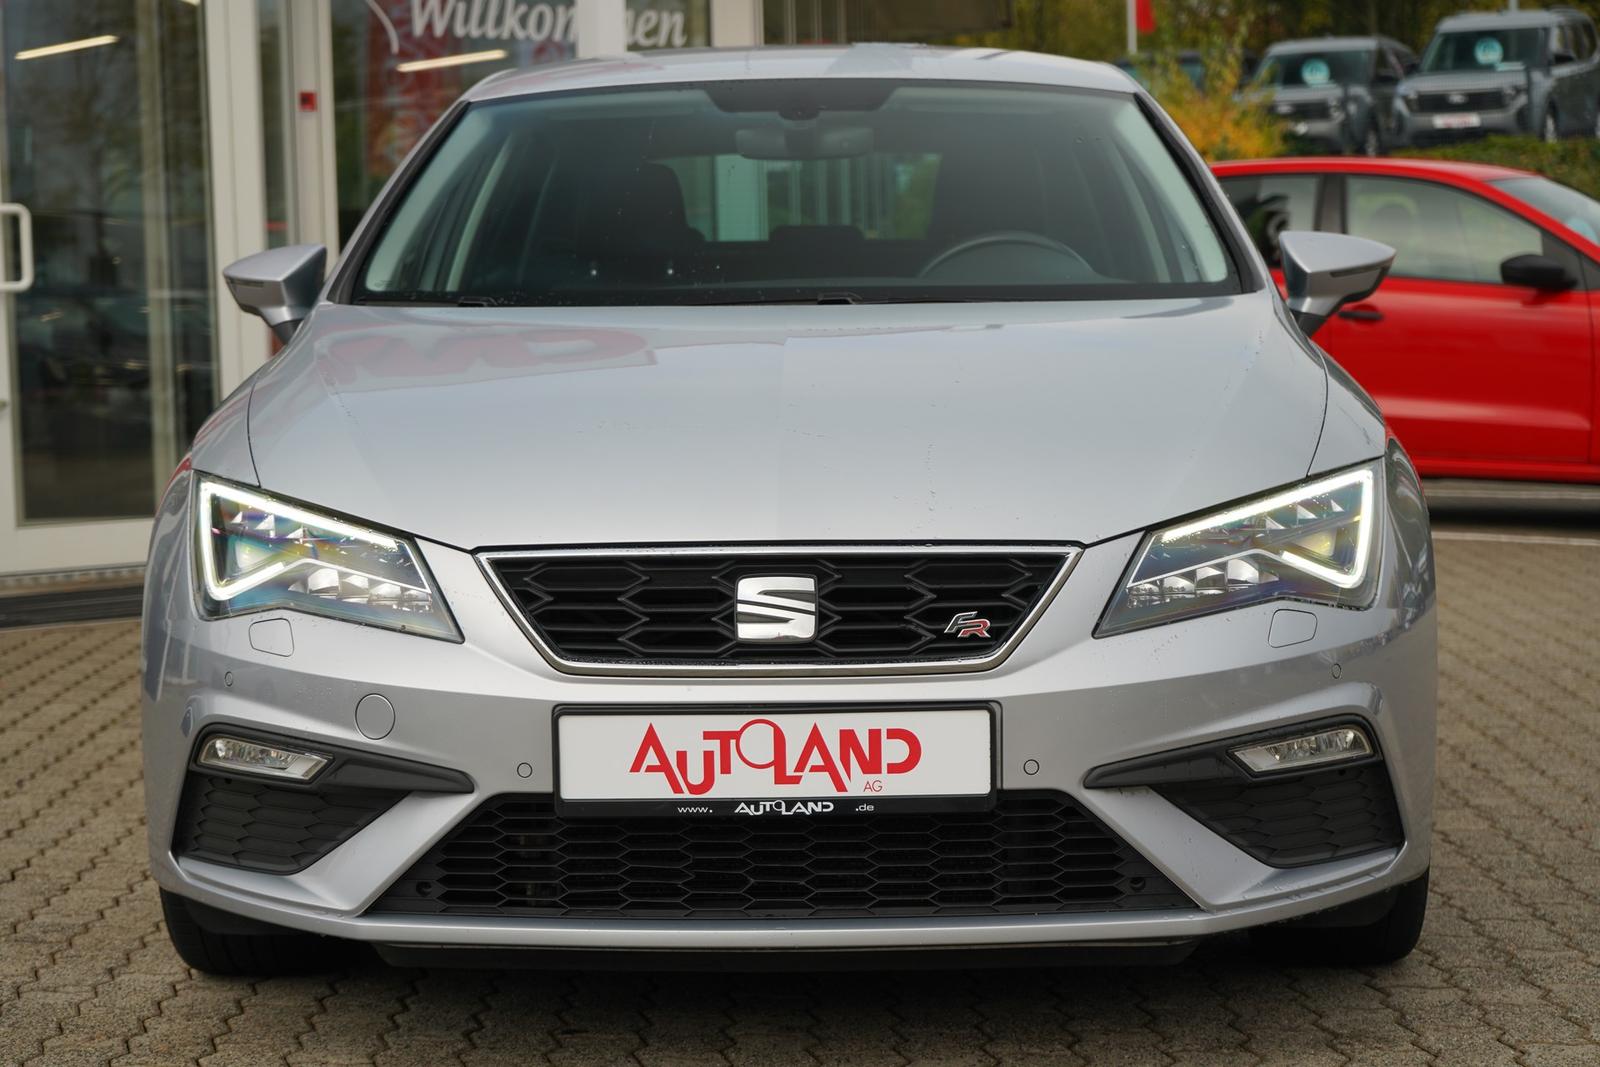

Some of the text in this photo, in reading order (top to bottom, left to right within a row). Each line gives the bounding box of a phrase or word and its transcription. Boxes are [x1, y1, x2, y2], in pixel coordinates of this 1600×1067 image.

[411, 0, 688, 47] Willkomen
[944, 611, 991, 638] FR
[629, 718, 922, 795] AUTOLAND
[863, 780, 883, 793] AG
[734, 800, 834, 816] AUTOLAND
[855, 804, 875, 813] .de
